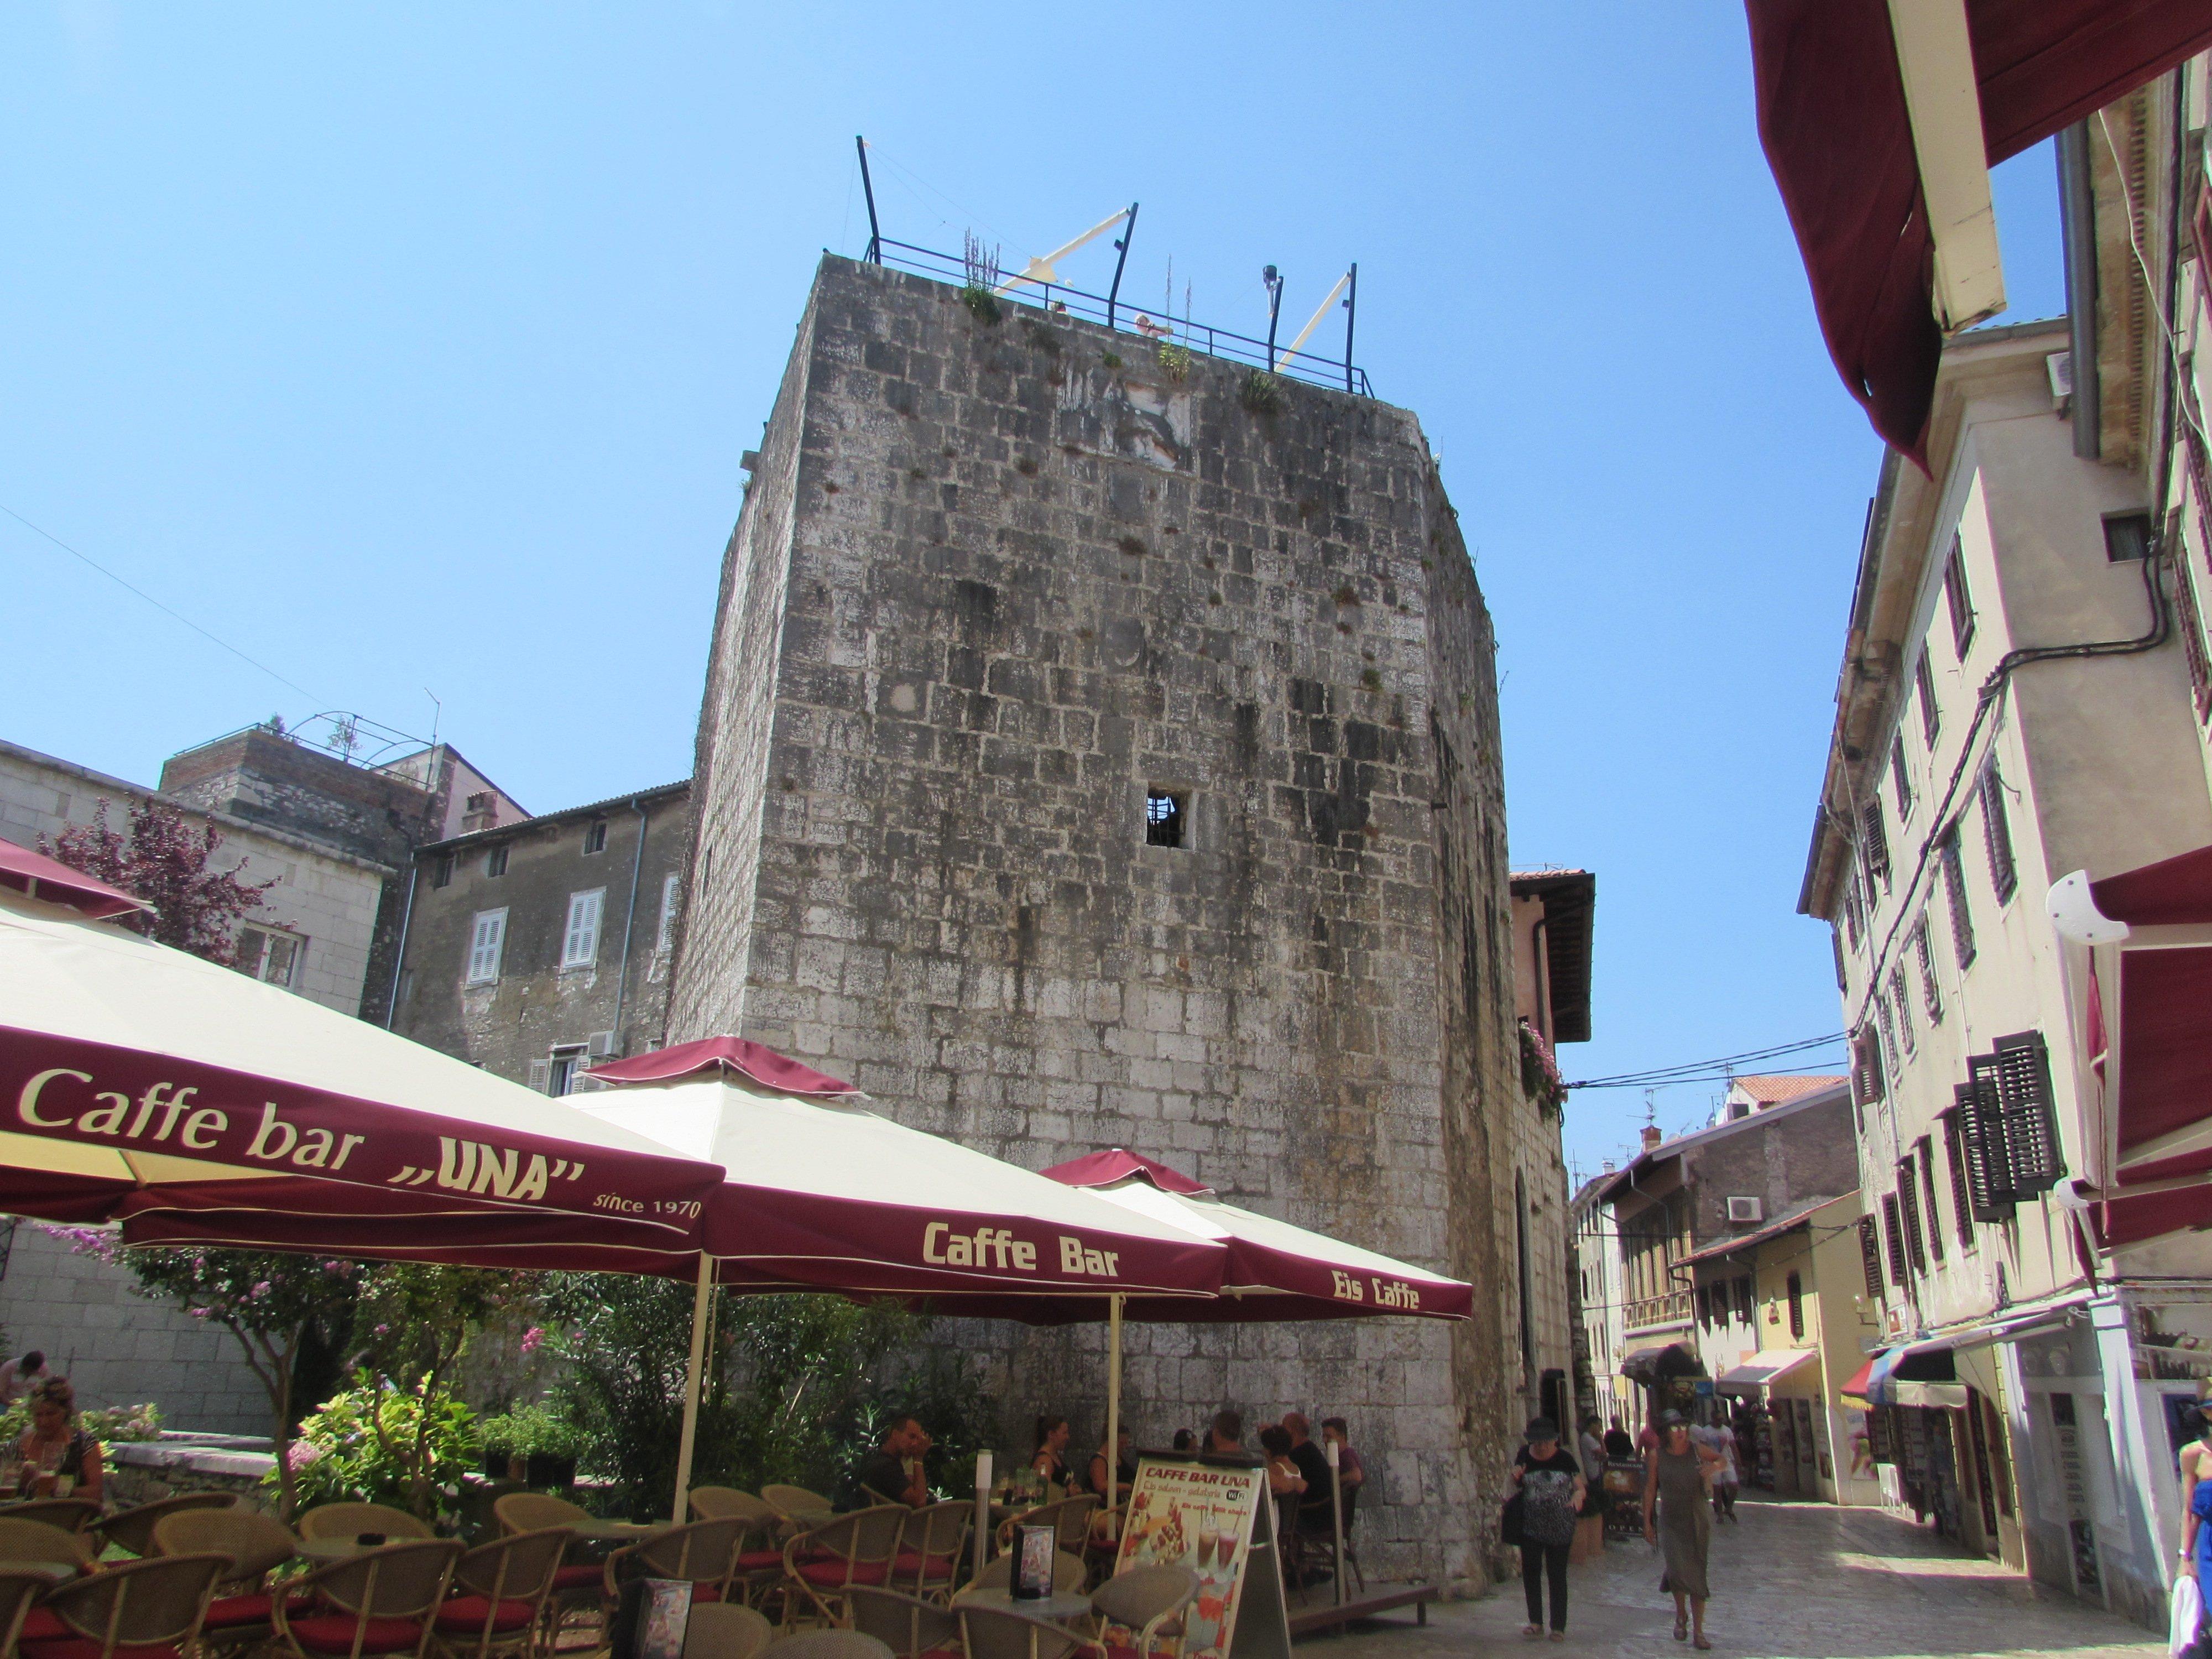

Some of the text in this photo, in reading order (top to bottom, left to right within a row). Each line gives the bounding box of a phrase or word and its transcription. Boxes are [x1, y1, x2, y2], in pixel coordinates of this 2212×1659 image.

[18, 1068, 229, 1149] Caffe
[245, 1101, 366, 1170] bar
[592, 1192, 702, 1219] since 1970
[923, 1221, 1119, 1277] Caffe Bar
[1331, 1270, 1420, 1310] Eis Caffe
[1145, 1467, 1250, 1489] CAFFE BAR UNA
